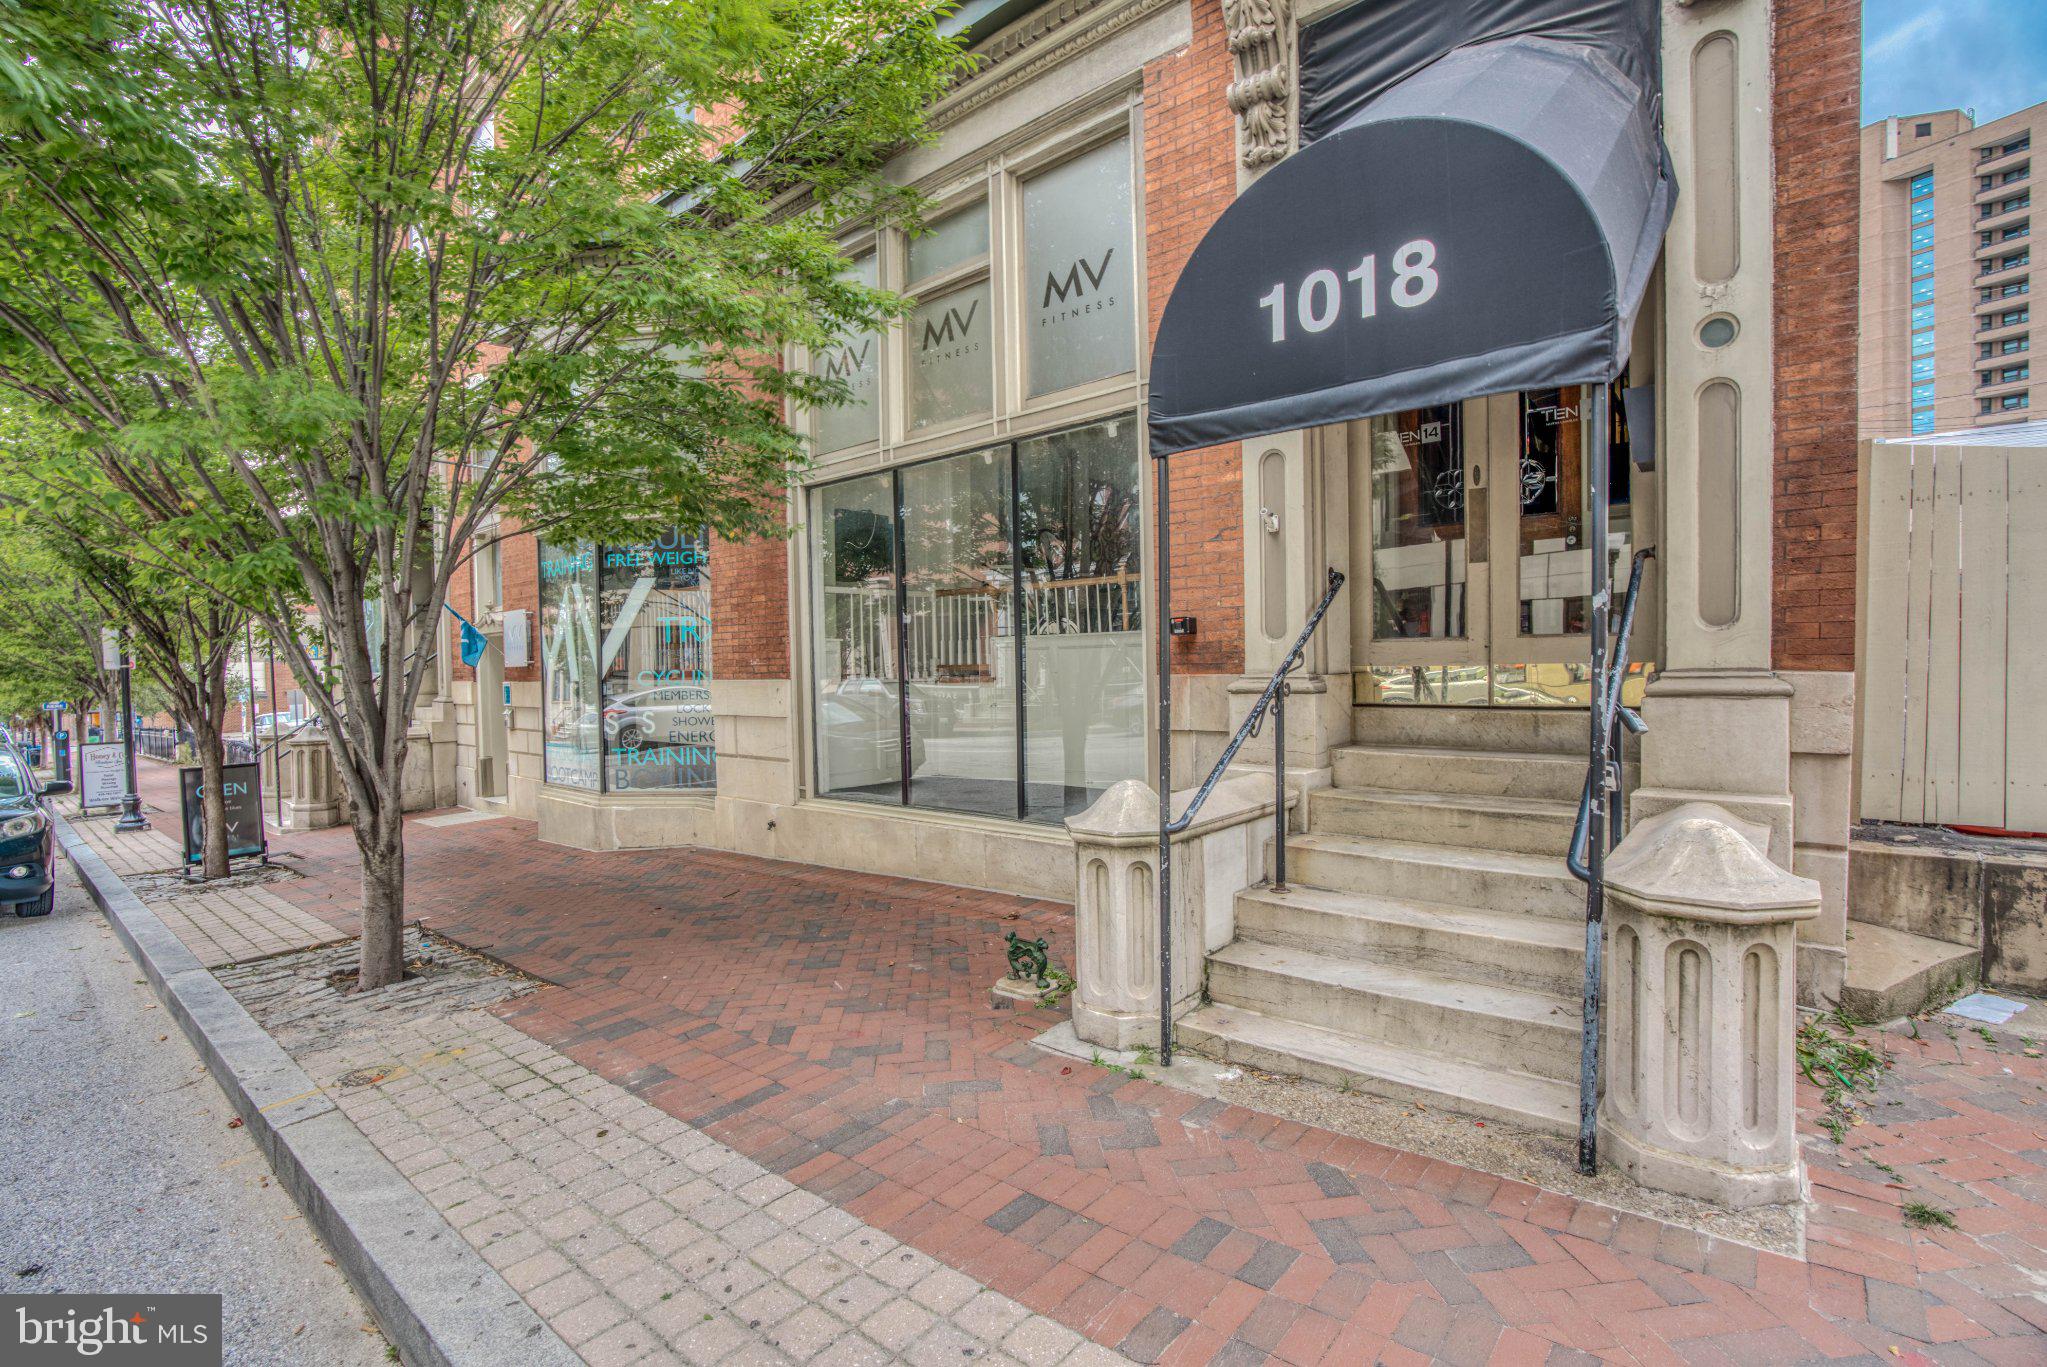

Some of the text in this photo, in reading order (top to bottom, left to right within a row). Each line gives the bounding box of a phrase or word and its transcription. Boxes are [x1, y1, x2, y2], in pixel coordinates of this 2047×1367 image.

[1043, 248, 1115, 308] MV
[1259, 239, 1439, 342] 1018
[1042, 297, 1115, 327] FITNESS
[922, 300, 979, 351] MV
[921, 342, 979, 367] FITNESS
[1423, 426, 1439, 438] 14
[607, 553, 645, 568] FREE
[653, 689, 710, 701] MEMBERS
[611, 747, 717, 767] TRAININ
[547, 764, 598, 788] OOTCAMP
[195, 782, 248, 799] OEN
